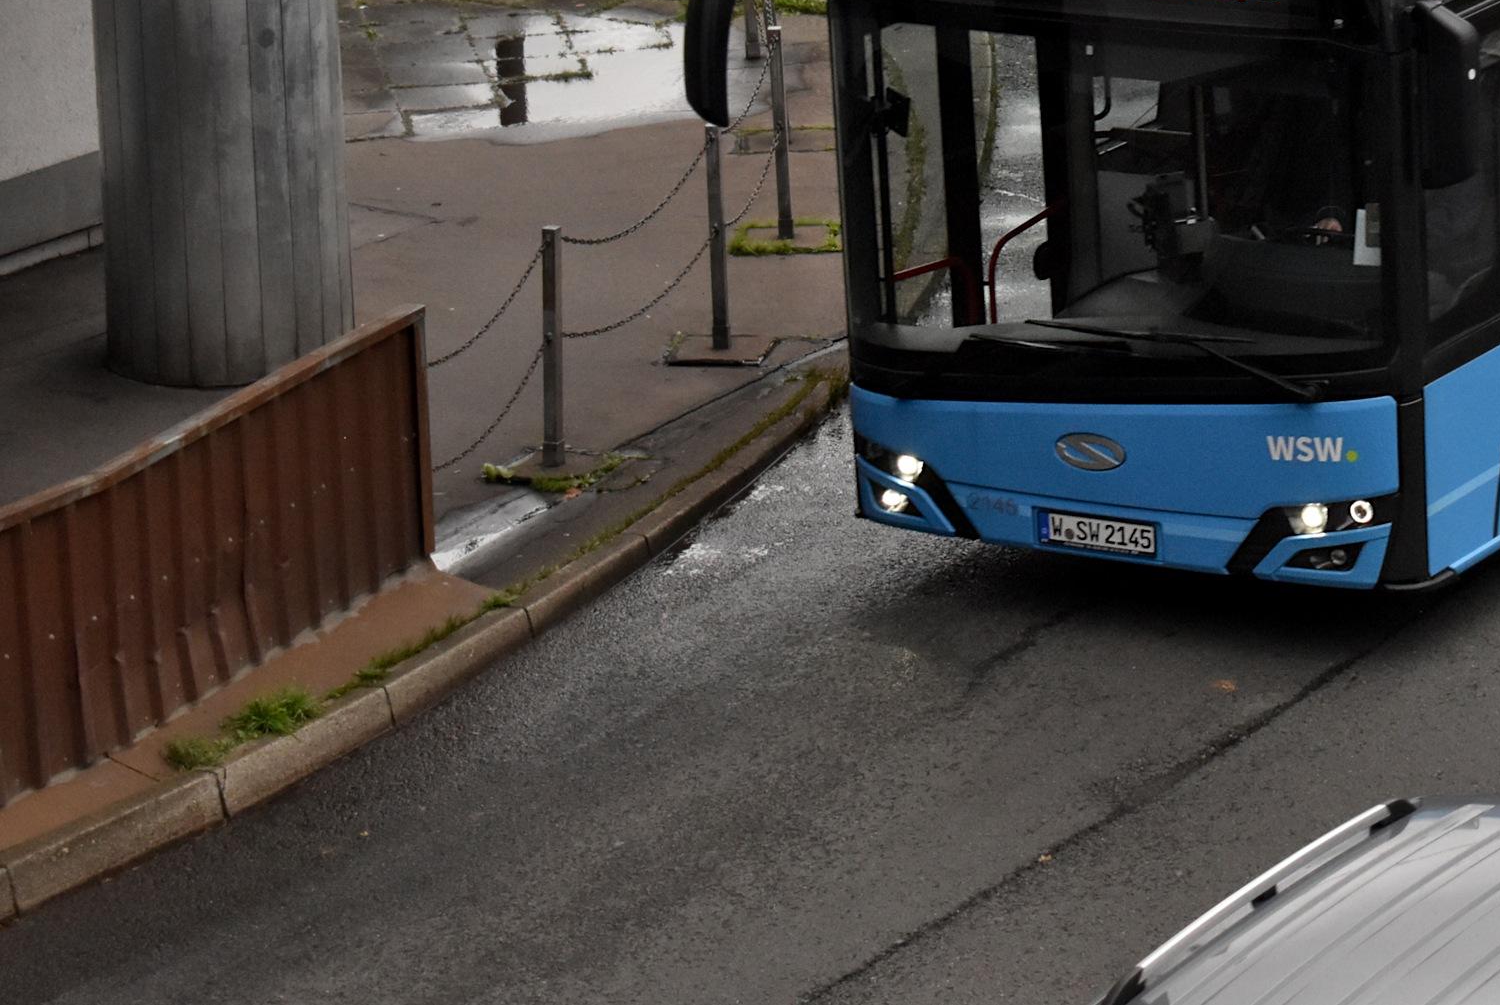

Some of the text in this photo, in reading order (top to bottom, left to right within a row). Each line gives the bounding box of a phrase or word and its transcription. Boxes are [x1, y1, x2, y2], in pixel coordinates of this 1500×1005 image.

[1051, 516, 1063, 537] W
[1076, 521, 1101, 542] SW
[1104, 524, 1152, 549] 2145
